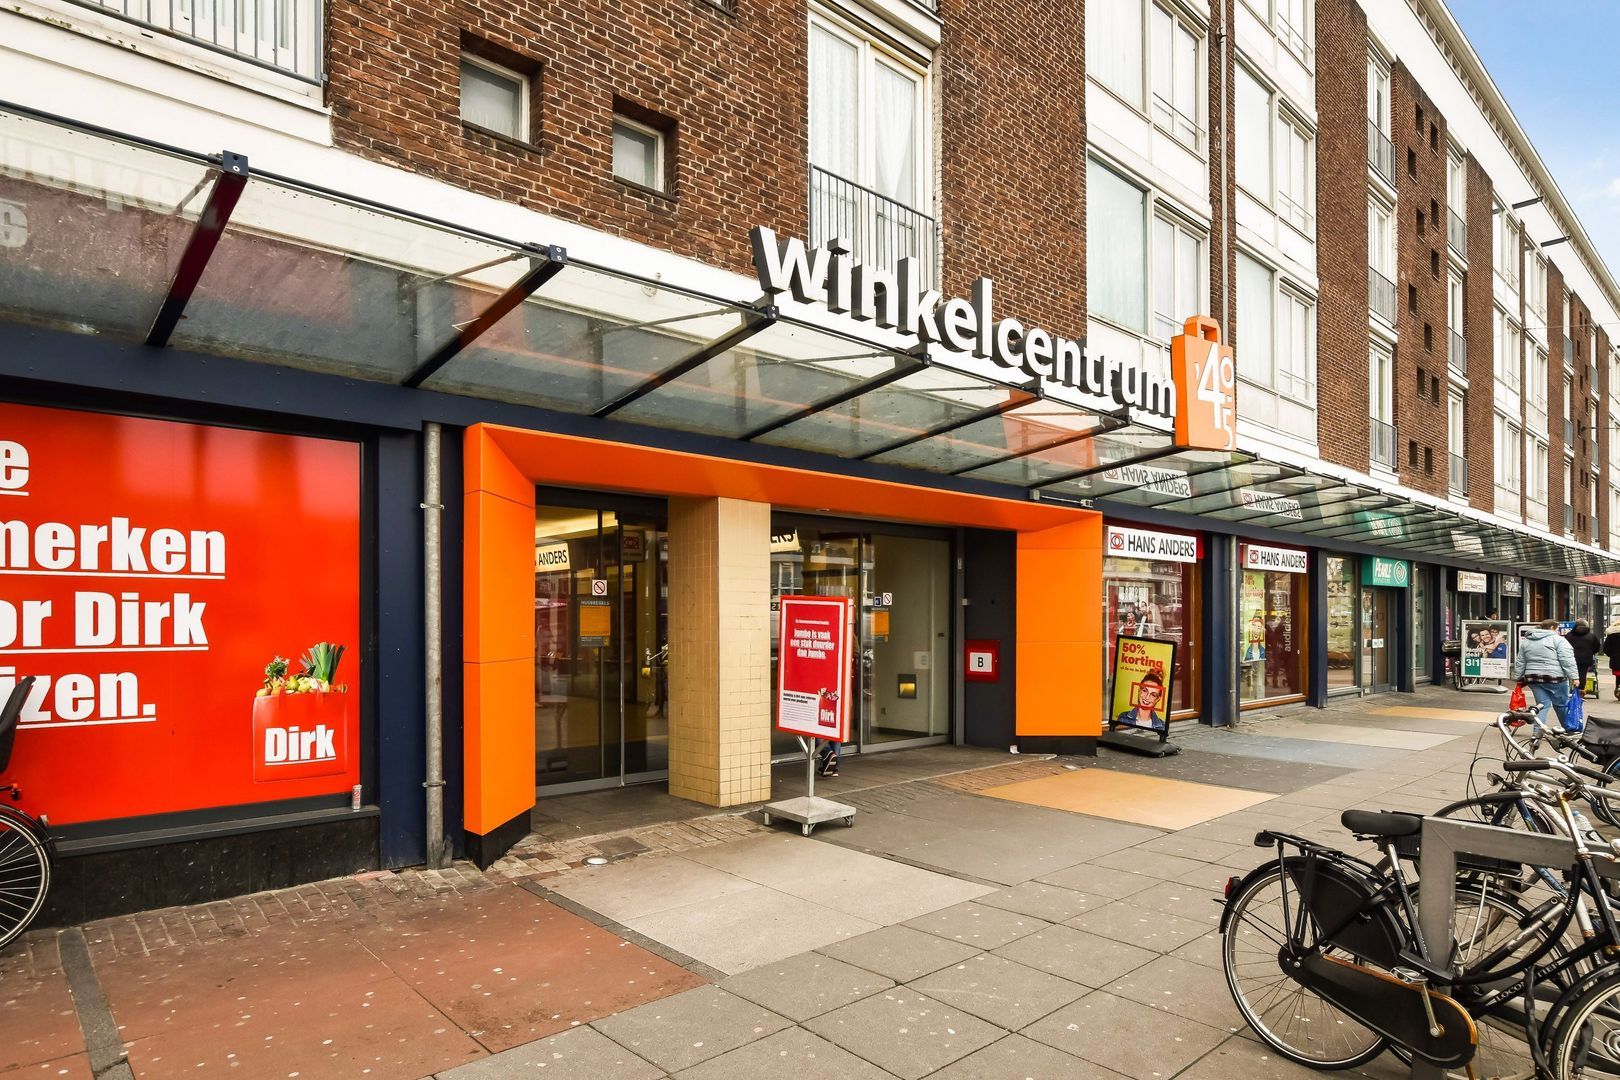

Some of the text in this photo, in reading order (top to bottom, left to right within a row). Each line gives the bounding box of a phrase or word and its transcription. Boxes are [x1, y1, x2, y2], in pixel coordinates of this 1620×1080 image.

[1128, 534, 1195, 558] HANS ANDERS
[538, 549, 568, 566] ANDERS
[1260, 553, 1306, 569] HANS ANDERS
[75, 591, 208, 647] Dirk
[1122, 642, 1146, 655] 50%
[977, 656, 984, 668] B
[1121, 652, 1163, 671] korting
[820, 709, 835, 723] Dirk
[265, 725, 336, 763] Dirk
